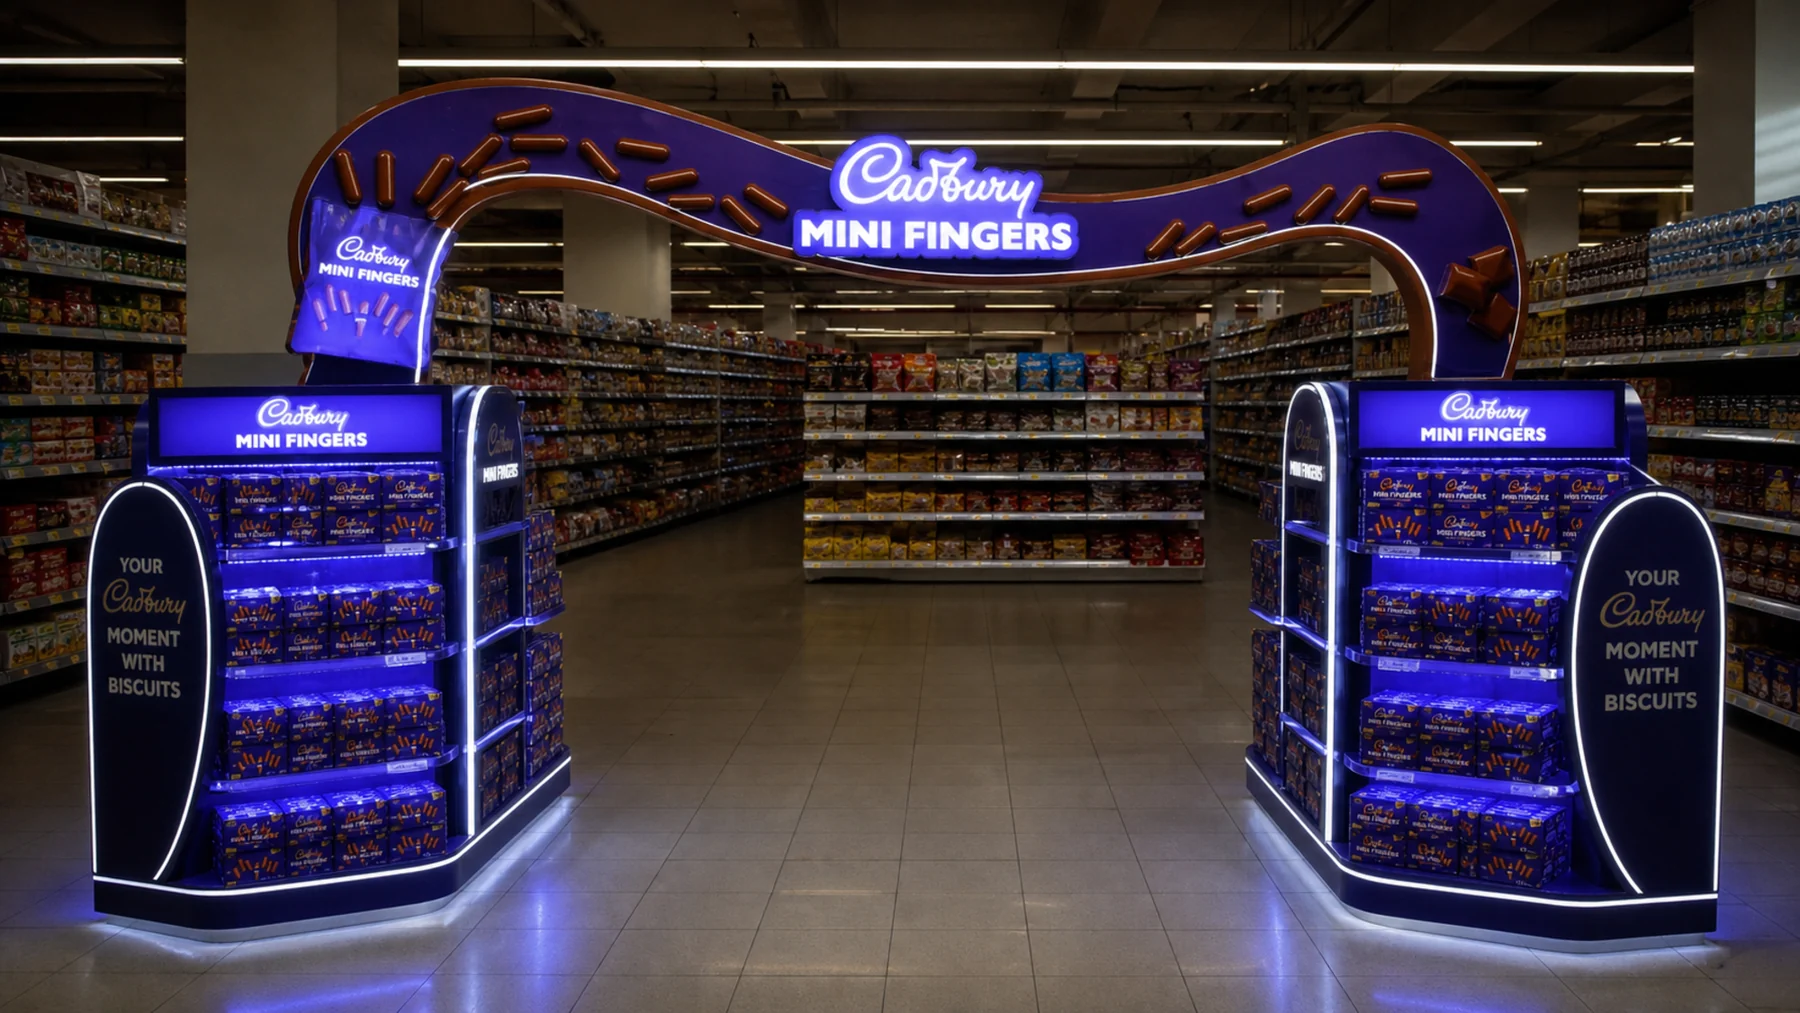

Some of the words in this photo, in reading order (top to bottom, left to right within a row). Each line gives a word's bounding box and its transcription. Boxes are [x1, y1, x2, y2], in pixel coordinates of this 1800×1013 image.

[839, 142, 1035, 219] Cadbury
[801, 219, 892, 249] MINI
[904, 221, 1073, 251] FINGERS
[336, 235, 410, 273] Cadbury
[318, 262, 354, 278] MINI
[357, 268, 420, 288] FINGERS
[257, 398, 349, 431] Cadbury
[1441, 392, 1529, 426] Cadbury
[235, 433, 281, 448] MINI
[285, 432, 368, 448] FINGERS
[1420, 427, 1463, 442] MINI
[1467, 426, 1547, 442] FINGERS
[120, 557, 163, 574] YOUR
[1625, 569, 1680, 586] YOUR
[103, 578, 186, 625] Cadbury
[1600, 591, 1706, 633] Cadbury
[107, 627, 181, 648] MOMENT
[1606, 640, 1699, 660] MOMENT
[121, 653, 165, 672] WITH
[1624, 666, 1679, 685] WITH
[108, 677, 181, 699] BISCUITS
[1604, 691, 1698, 712] BISCUITS
